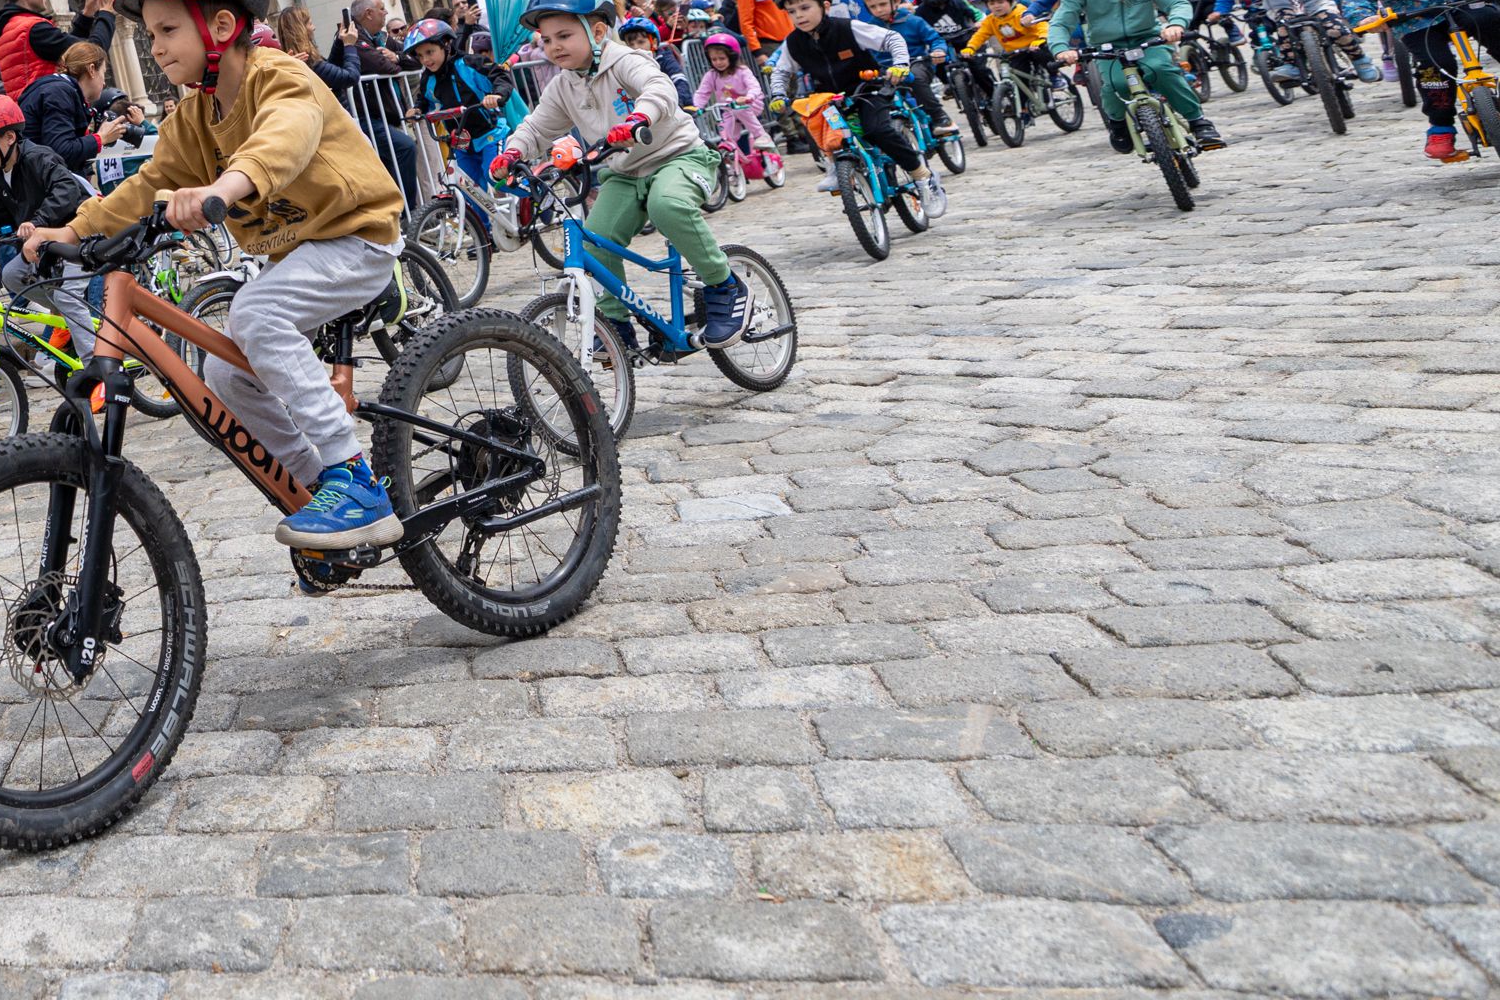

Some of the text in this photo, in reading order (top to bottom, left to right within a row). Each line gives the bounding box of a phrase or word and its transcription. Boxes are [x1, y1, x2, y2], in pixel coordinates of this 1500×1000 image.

[103, 157, 117, 172] 94
[246, 229, 297, 255] ESSENTIALS
[587, 347, 593, 358] 16
[114, 394, 131, 404] RST
[203, 396, 298, 495] woom
[482, 599, 529, 619] RON
[82, 637, 96, 661] 20
[151, 560, 198, 758] SCHWALBE
[148, 687, 164, 712] woom
[160, 671, 168, 687] OFF
